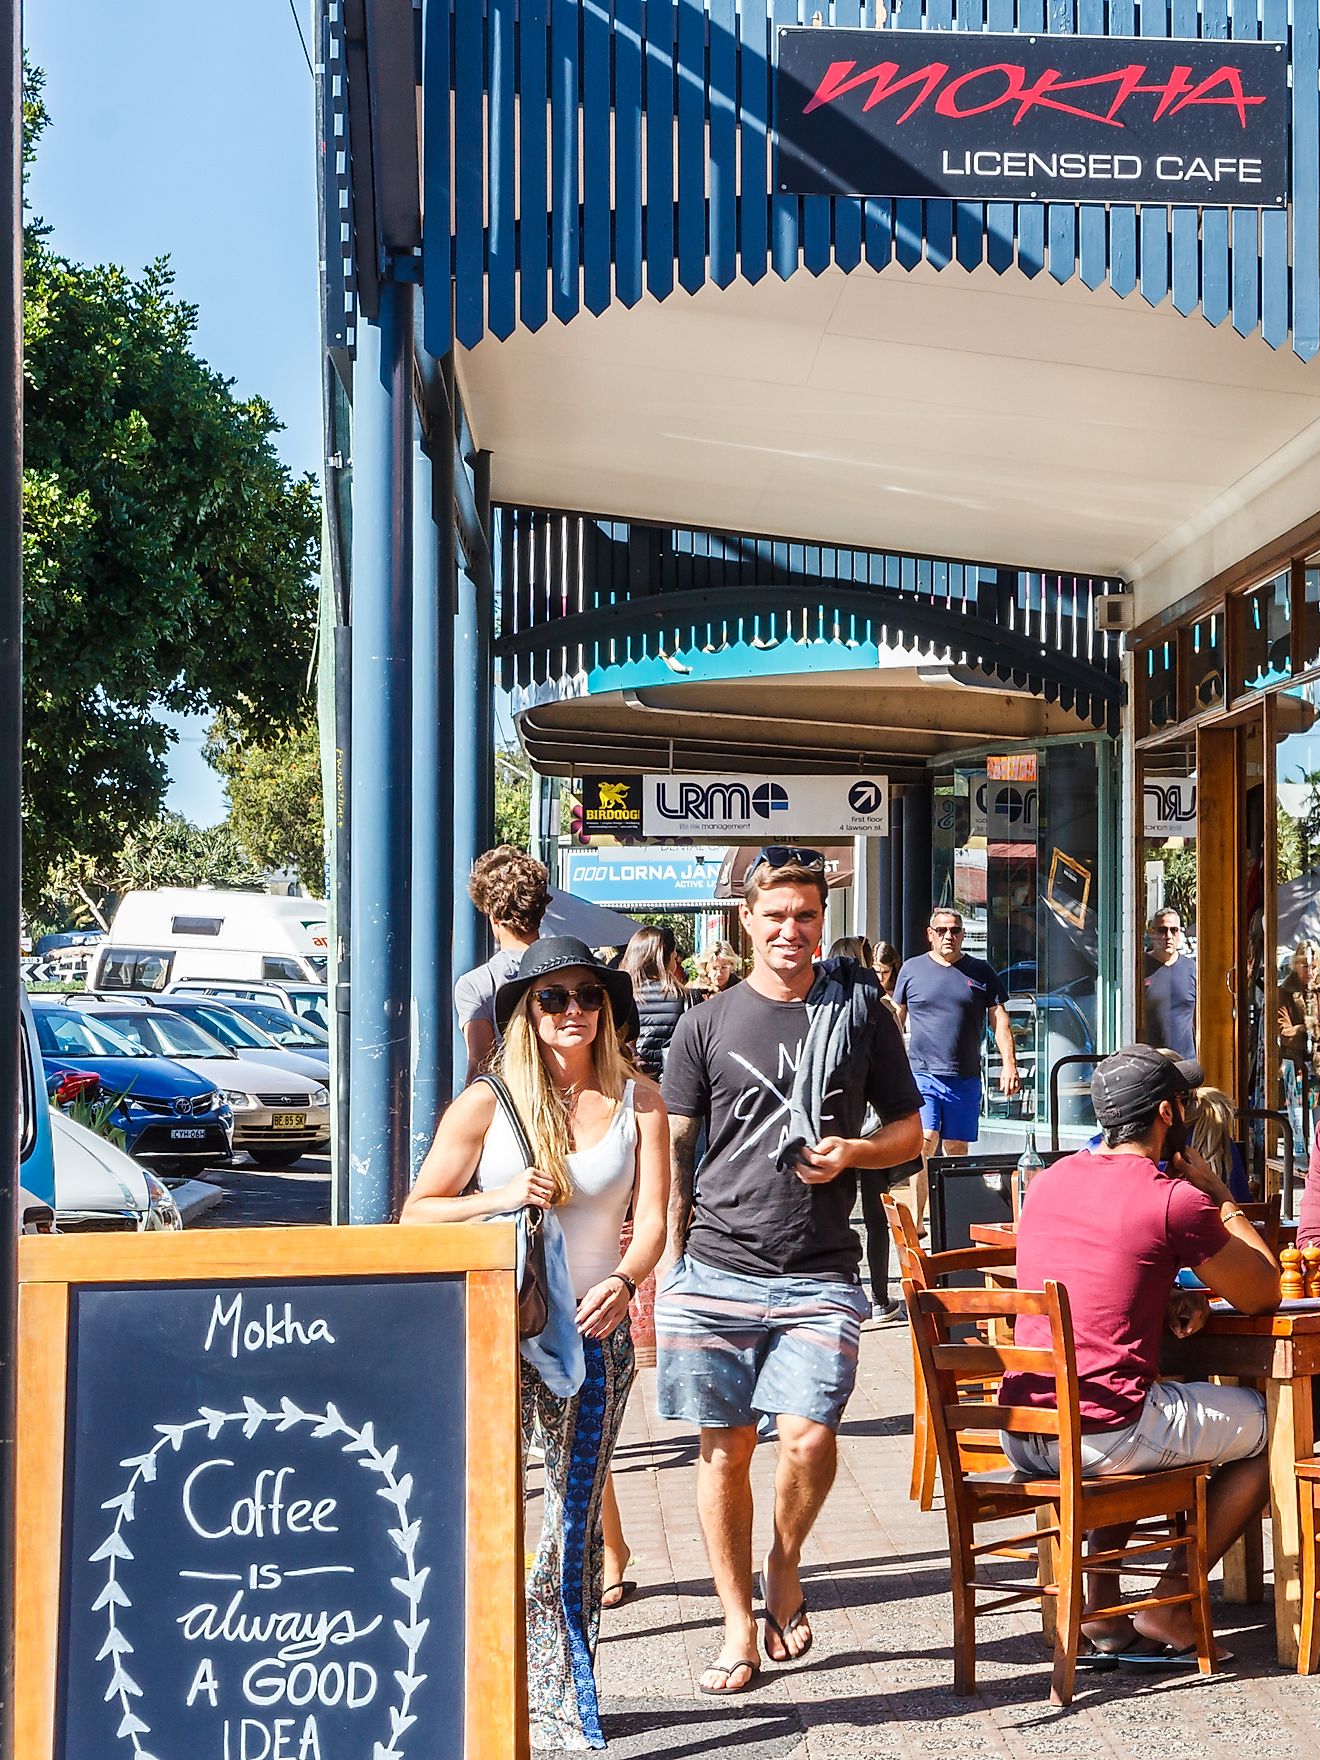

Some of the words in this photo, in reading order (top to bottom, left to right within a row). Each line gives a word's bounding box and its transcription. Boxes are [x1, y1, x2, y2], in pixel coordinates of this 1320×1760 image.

[803, 61, 1266, 128] MOKHA
[942, 150, 1142, 180] LICENSED
[1156, 155, 1262, 183] CAFE
[656, 782, 751, 820] LRM
[701, 822, 751, 830] management
[610, 865, 677, 881] LORNA
[681, 864, 721, 881] JAN
[204, 1292, 335, 1358] Mokha
[183, 1459, 339, 1538] Coffee
[176, 1589, 382, 1660] always
[187, 1658, 217, 1706] A
[242, 1660, 377, 1708] GOOD
[223, 1714, 321, 1760] IDEA
